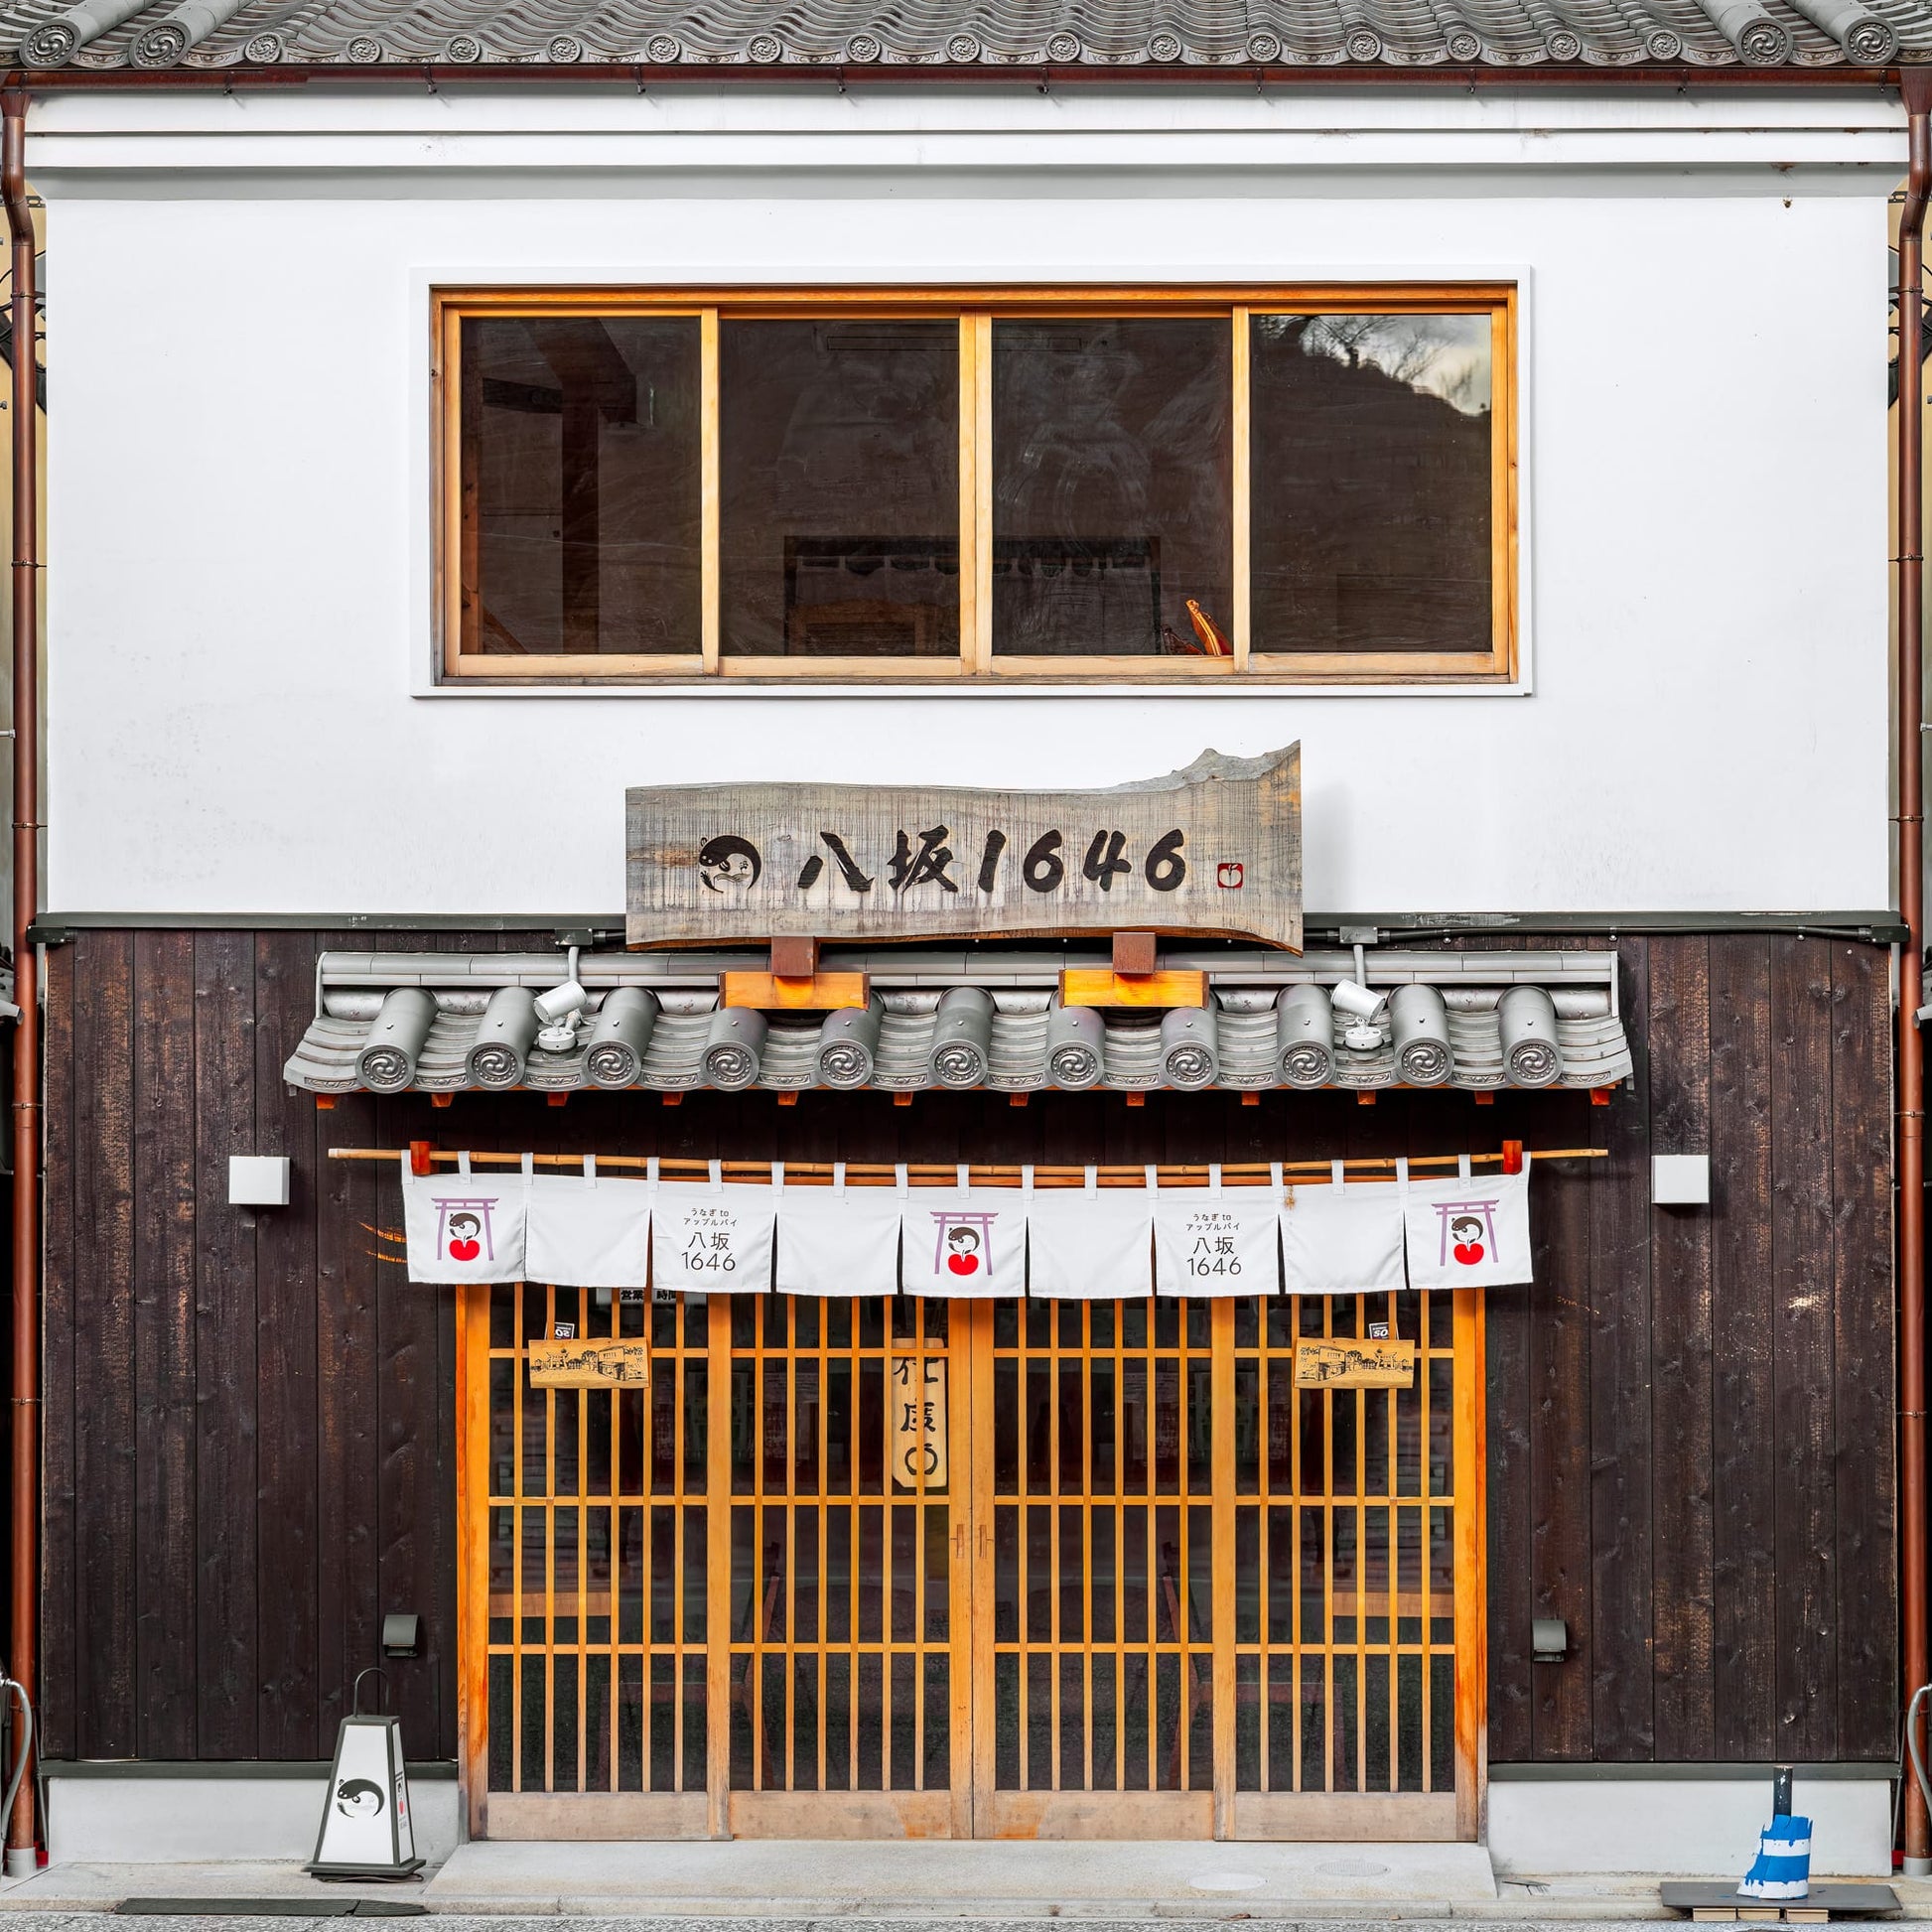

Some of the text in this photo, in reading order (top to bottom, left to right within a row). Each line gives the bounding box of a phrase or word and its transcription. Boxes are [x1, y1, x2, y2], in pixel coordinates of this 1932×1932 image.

[797, 824, 1185, 894] 八坂1646
[688, 1231, 730, 1251] 八坂
[1192, 1236, 1234, 1255] 八坂
[681, 1251, 736, 1272] 1646
[1186, 1256, 1242, 1276] 1646
